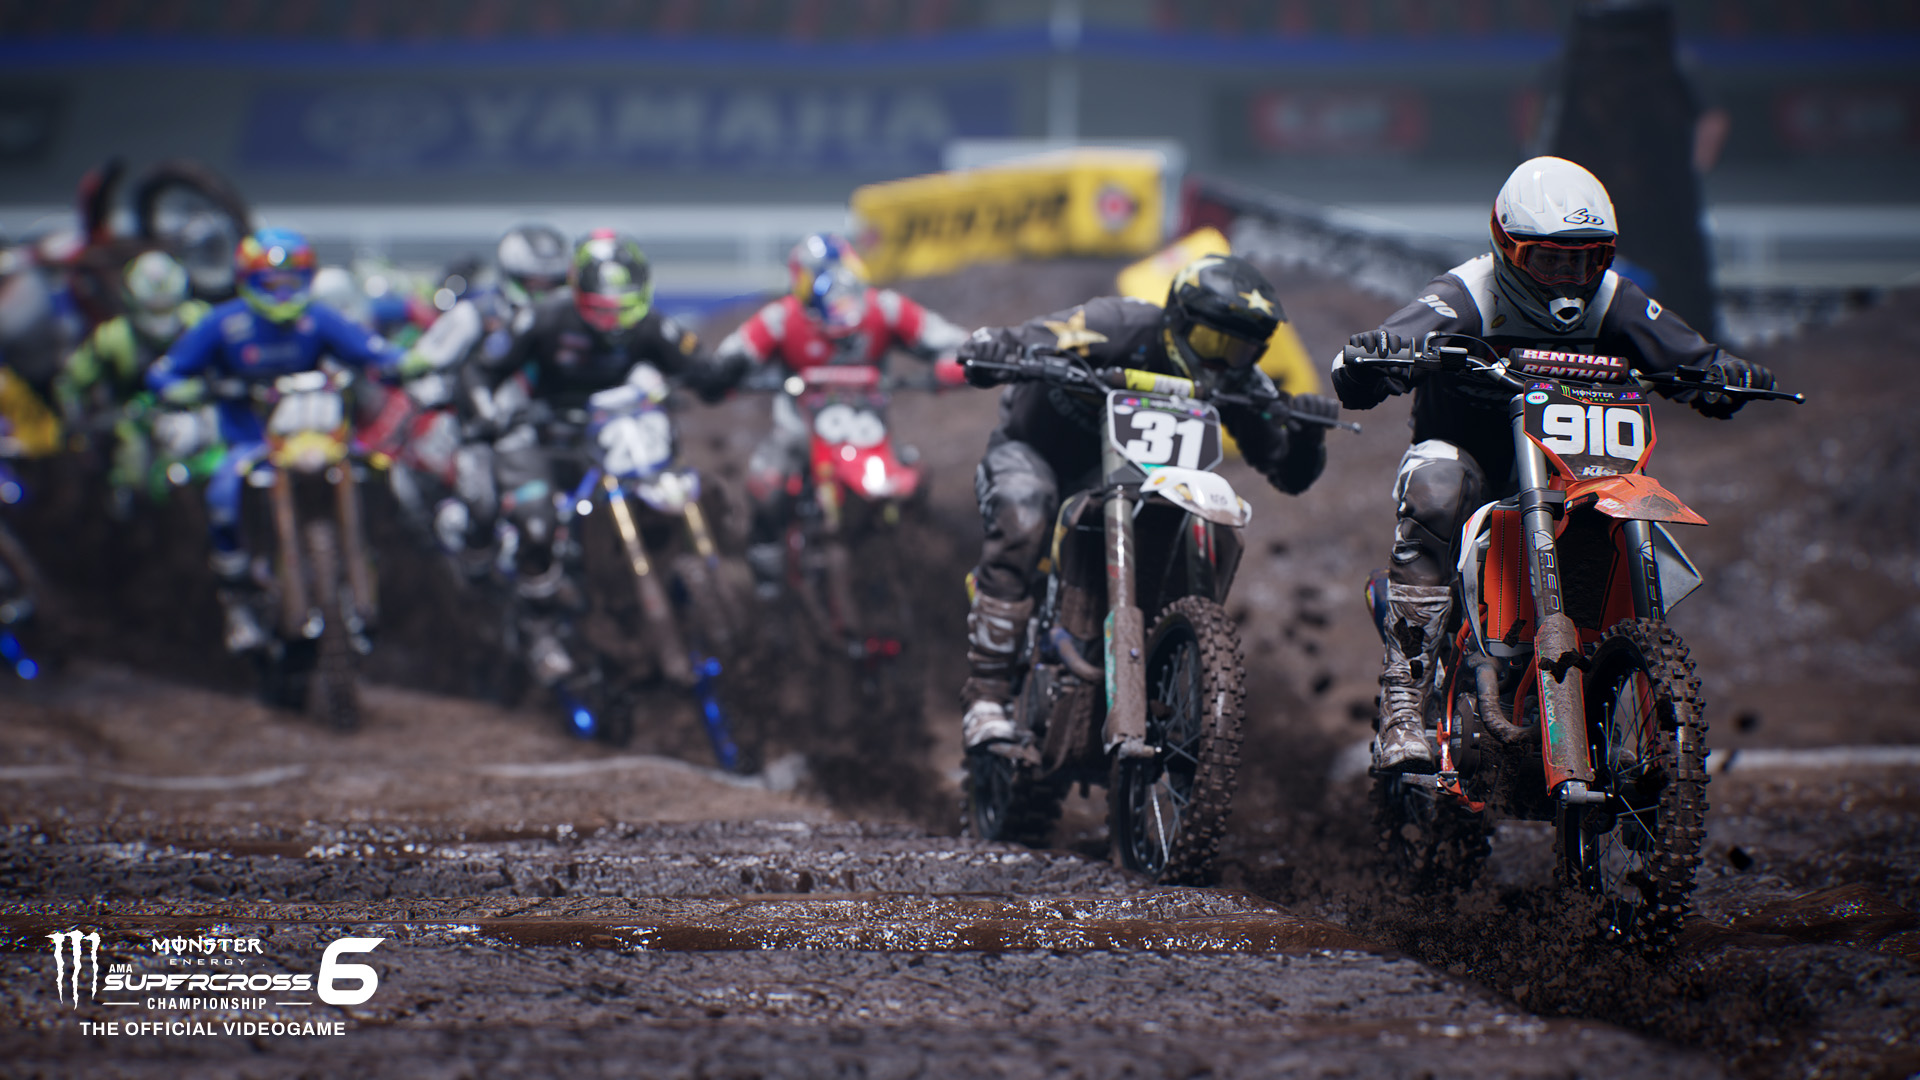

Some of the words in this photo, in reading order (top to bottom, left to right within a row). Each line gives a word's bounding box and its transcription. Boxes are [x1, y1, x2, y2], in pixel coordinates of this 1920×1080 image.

[1563, 208, 1604, 225] 6D
[1522, 350, 1623, 367] RENTHAL
[1522, 364, 1620, 380] RENTHAL
[1571, 388, 1615, 399] MONSTER
[1126, 411, 1205, 470] 31
[1542, 404, 1645, 461] 910
